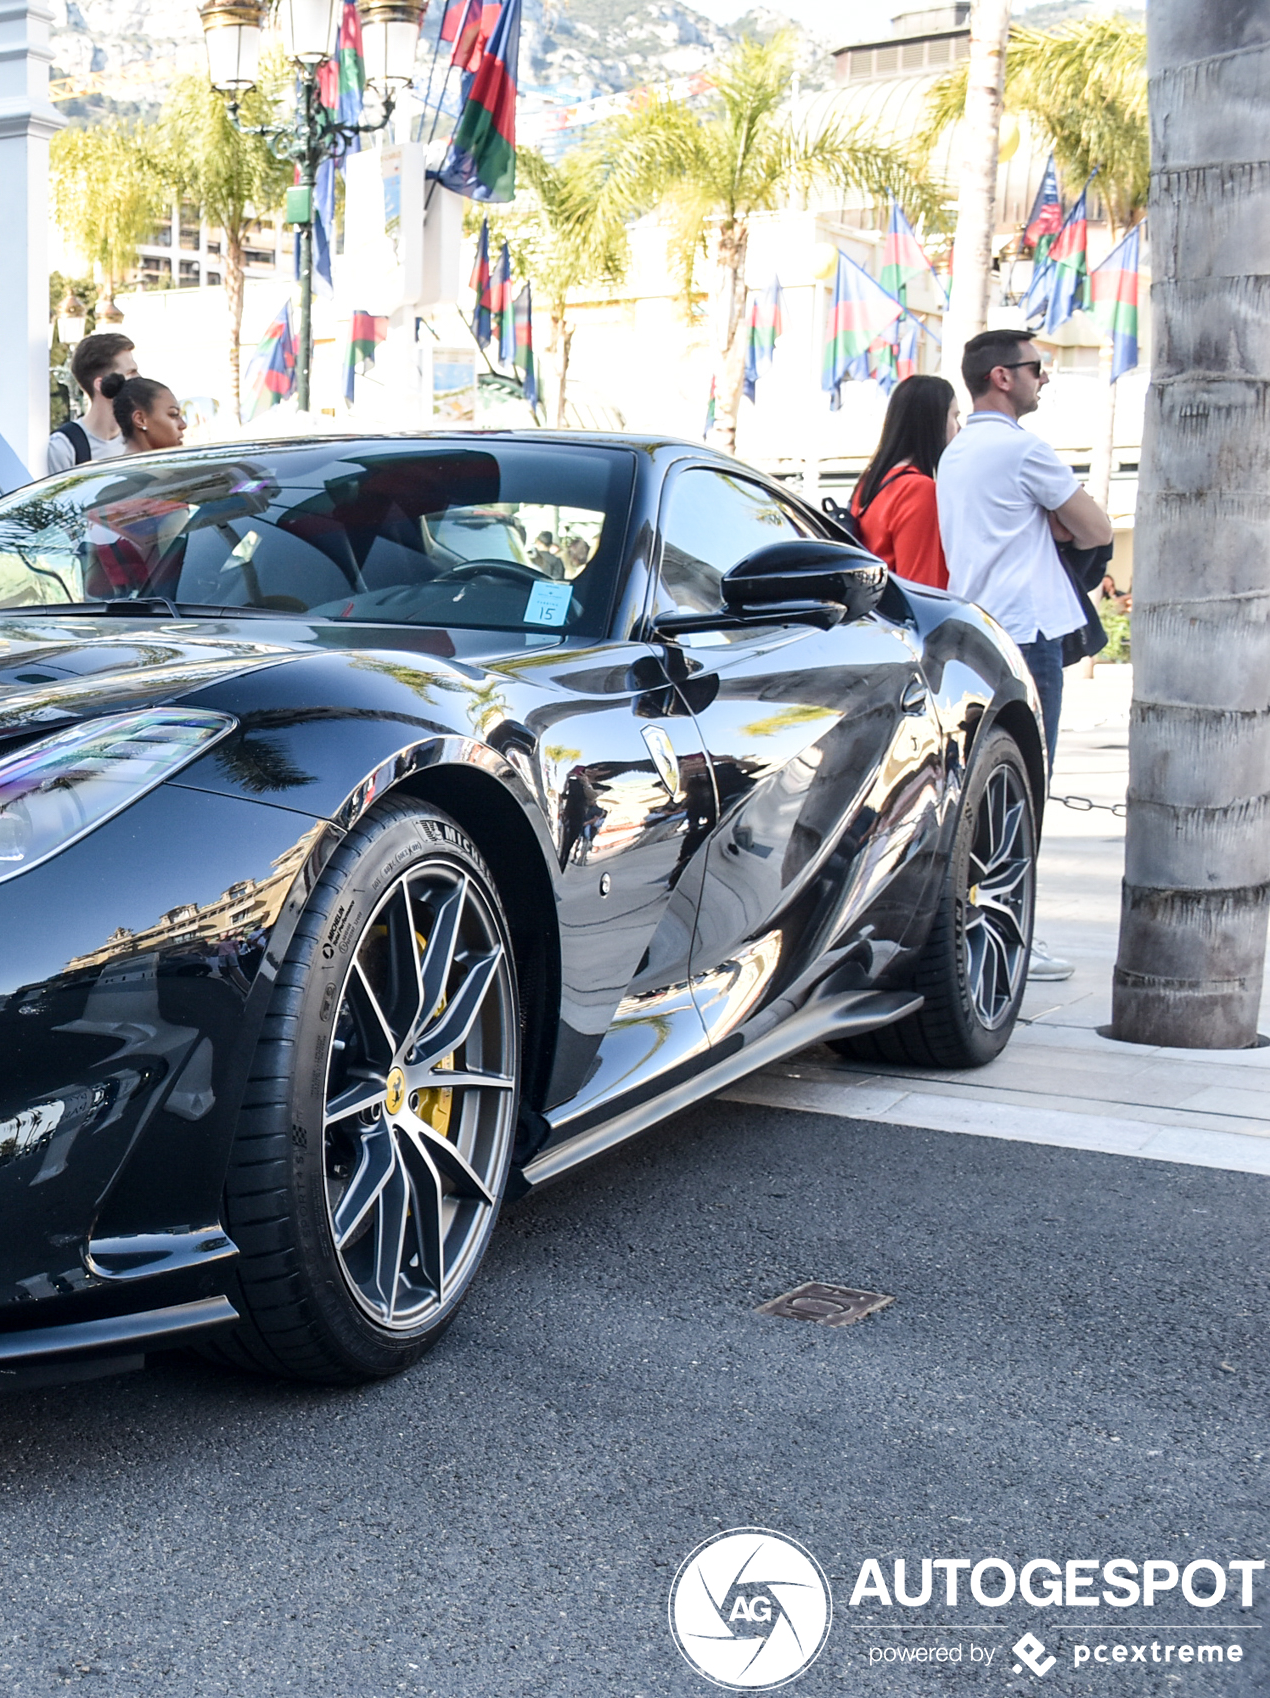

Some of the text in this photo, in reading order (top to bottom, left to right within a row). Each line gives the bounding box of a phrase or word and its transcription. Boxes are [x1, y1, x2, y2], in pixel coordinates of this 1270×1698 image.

[539, 606, 556, 621] 15
[328, 905, 345, 941] MICHELIN
[339, 900, 355, 933] Performance
